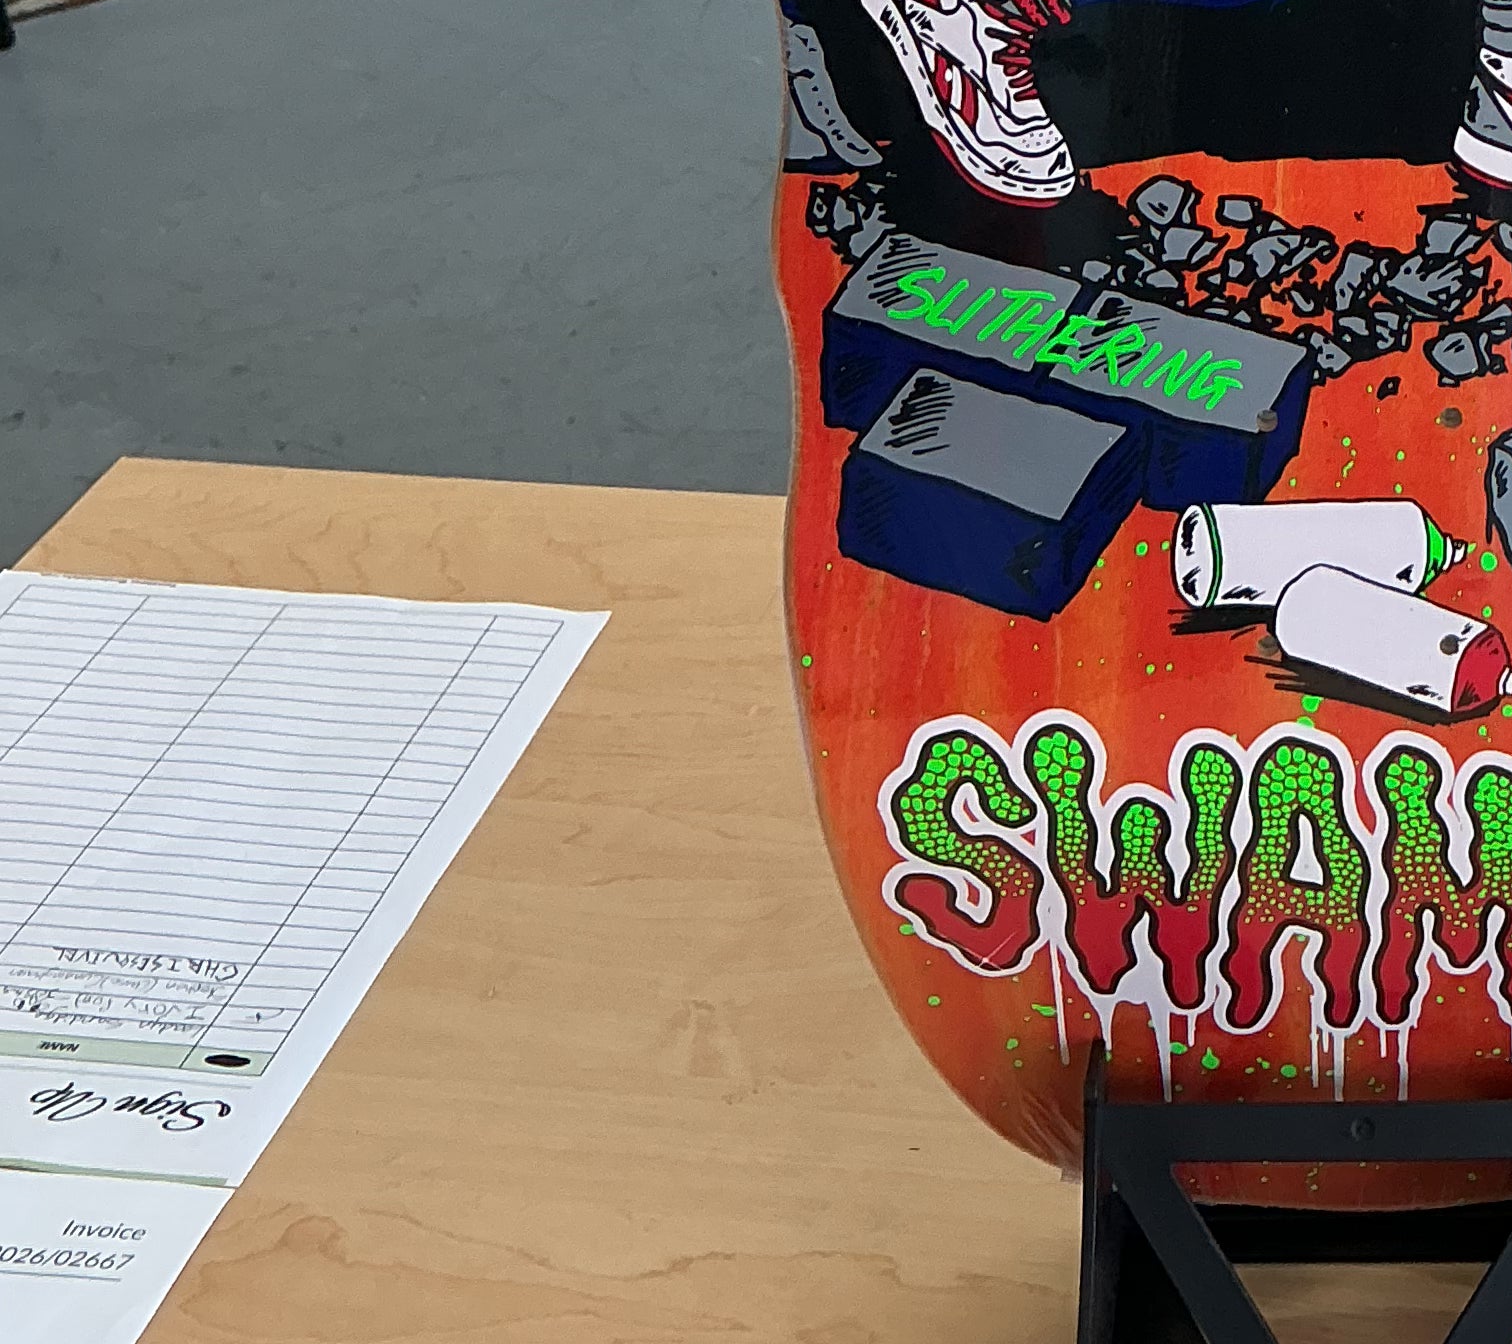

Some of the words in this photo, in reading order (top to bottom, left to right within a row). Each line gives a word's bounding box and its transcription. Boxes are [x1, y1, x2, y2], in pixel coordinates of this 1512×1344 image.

[887, 267, 1244, 410] SLITHERING
[29, 1081, 108, 1123] Up
[113, 1090, 233, 1133] Sign
[62, 1219, 147, 1241] Invoice
